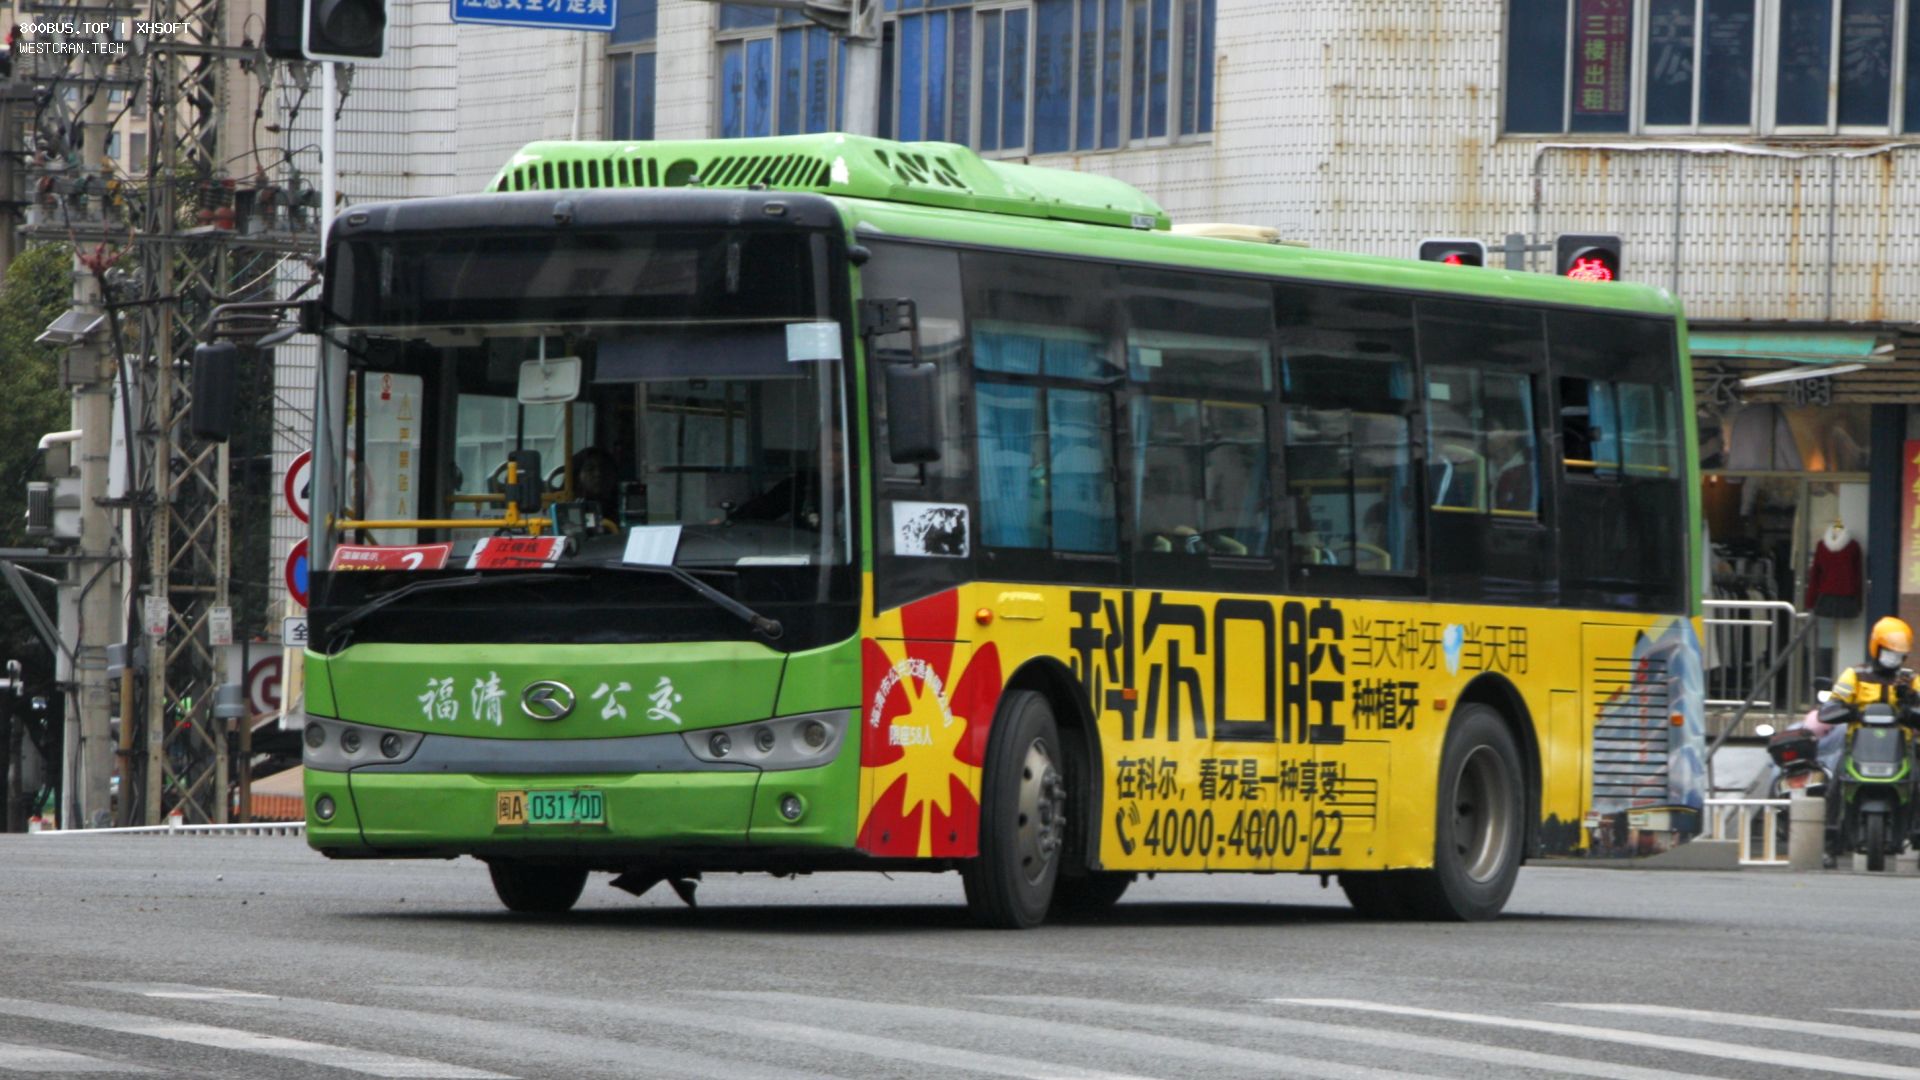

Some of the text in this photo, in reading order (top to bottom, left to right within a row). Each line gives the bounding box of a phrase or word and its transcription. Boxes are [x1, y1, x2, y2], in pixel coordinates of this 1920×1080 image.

[1069, 590, 1346, 745] 科尔口腔
[1351, 616, 1528, 675] 当天种牙 当天用
[418, 671, 682, 727] 福清 公交
[1352, 677, 1420, 731] 种植牙
[532, 795, 602, 820] 03170D
